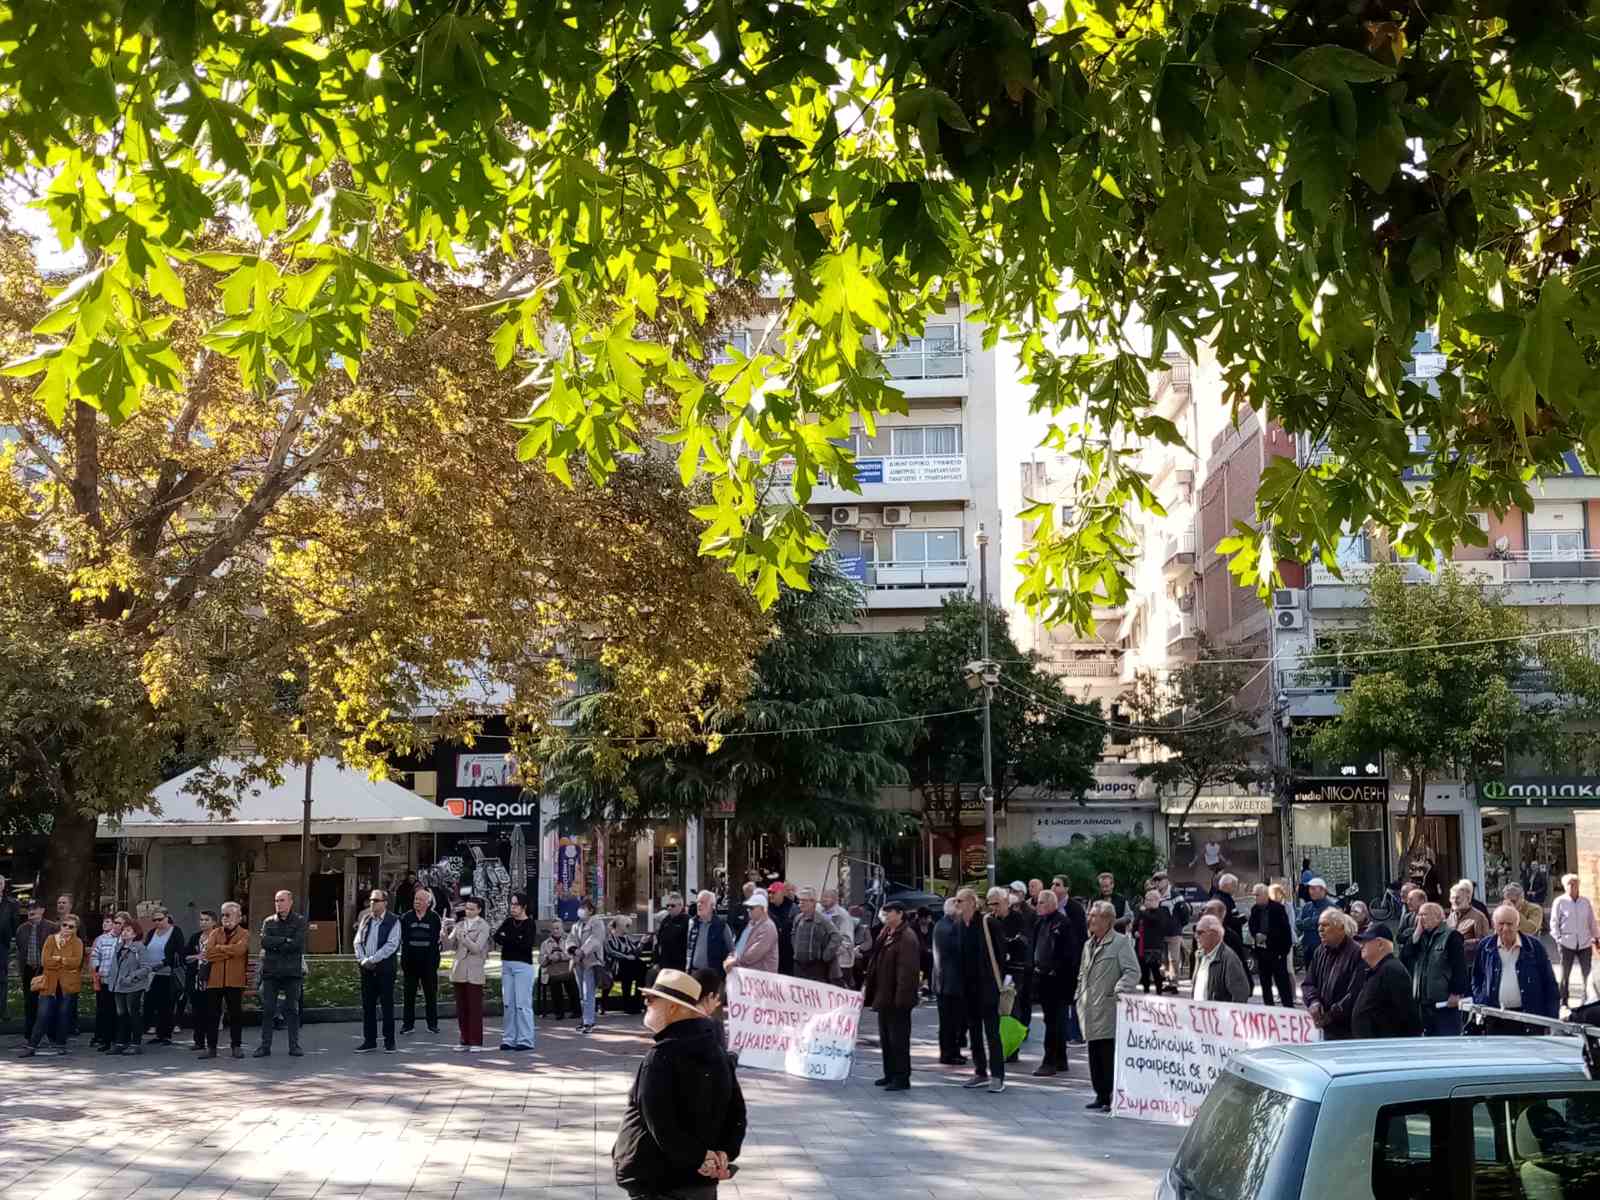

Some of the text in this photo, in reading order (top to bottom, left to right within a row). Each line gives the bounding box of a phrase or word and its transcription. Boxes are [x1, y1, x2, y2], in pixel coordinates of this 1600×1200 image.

[1229, 800, 1266, 810] SWEETS
[1295, 790, 1321, 801] studio
[467, 800, 536, 820] iRepair
[730, 1001, 750, 1020] ΟΥ
[1126, 998, 1313, 1043] ΑΥΞΗΣΕΙΣ ΣΤΙΣ ΣΥΝΤΑΞΕΙΣ
